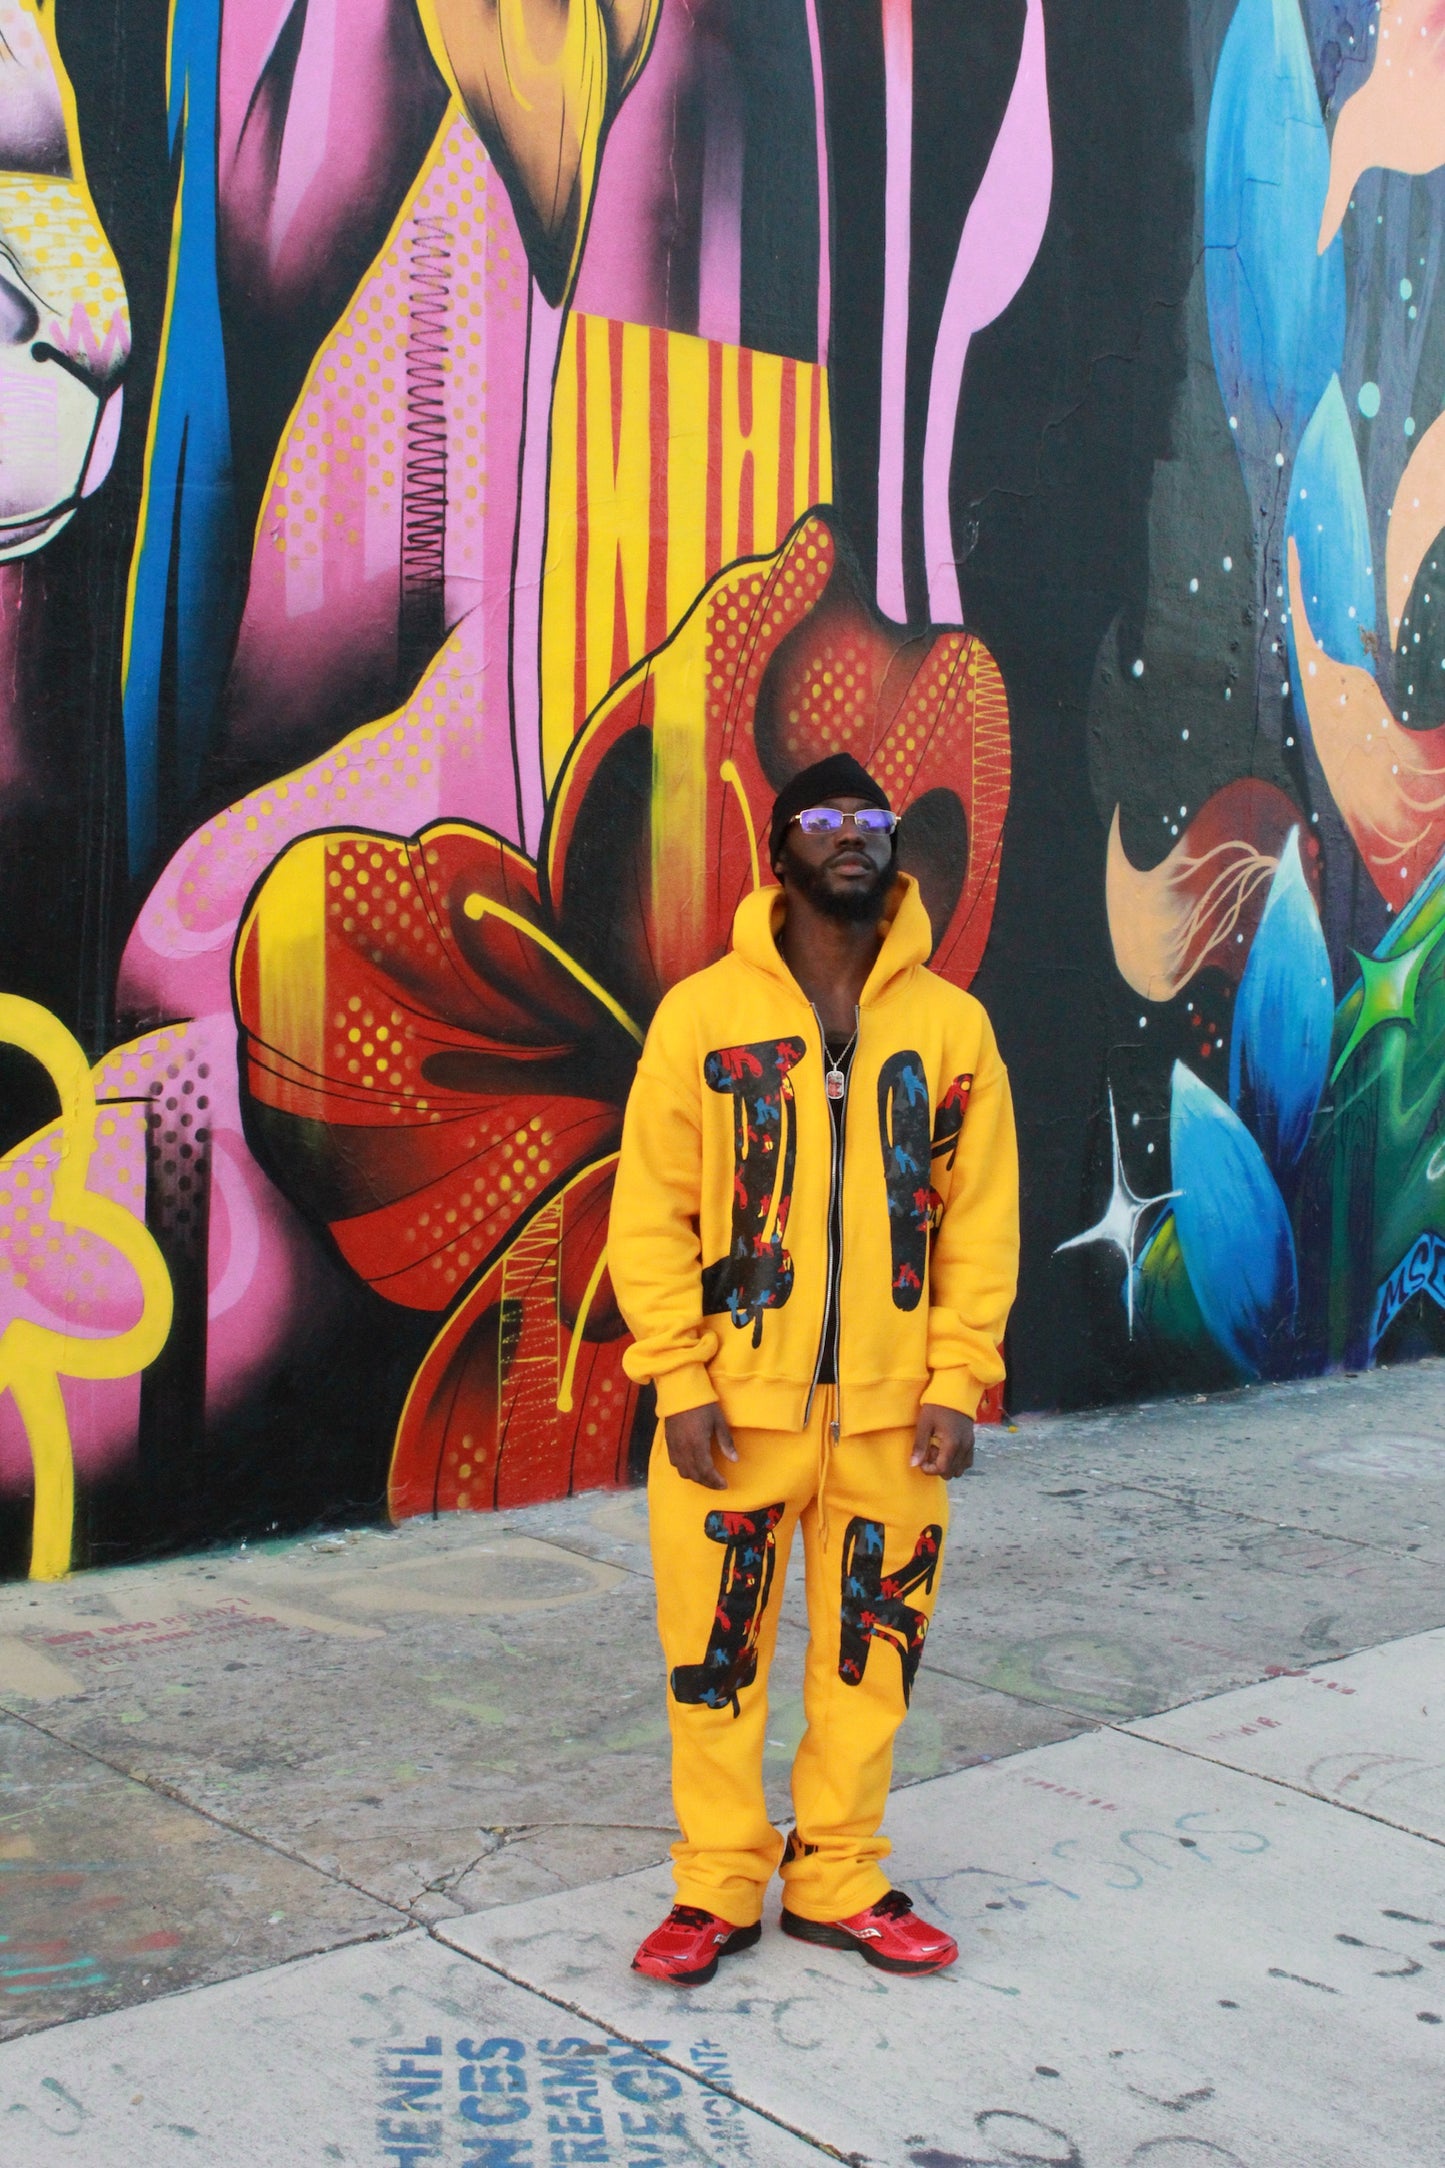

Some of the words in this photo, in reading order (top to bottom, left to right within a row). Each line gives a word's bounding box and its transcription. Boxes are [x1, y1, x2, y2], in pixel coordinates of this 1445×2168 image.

[375, 2035, 443, 2112] NFL
[455, 2036, 531, 2127] CBS
[537, 2037, 610, 2168] REAMS
